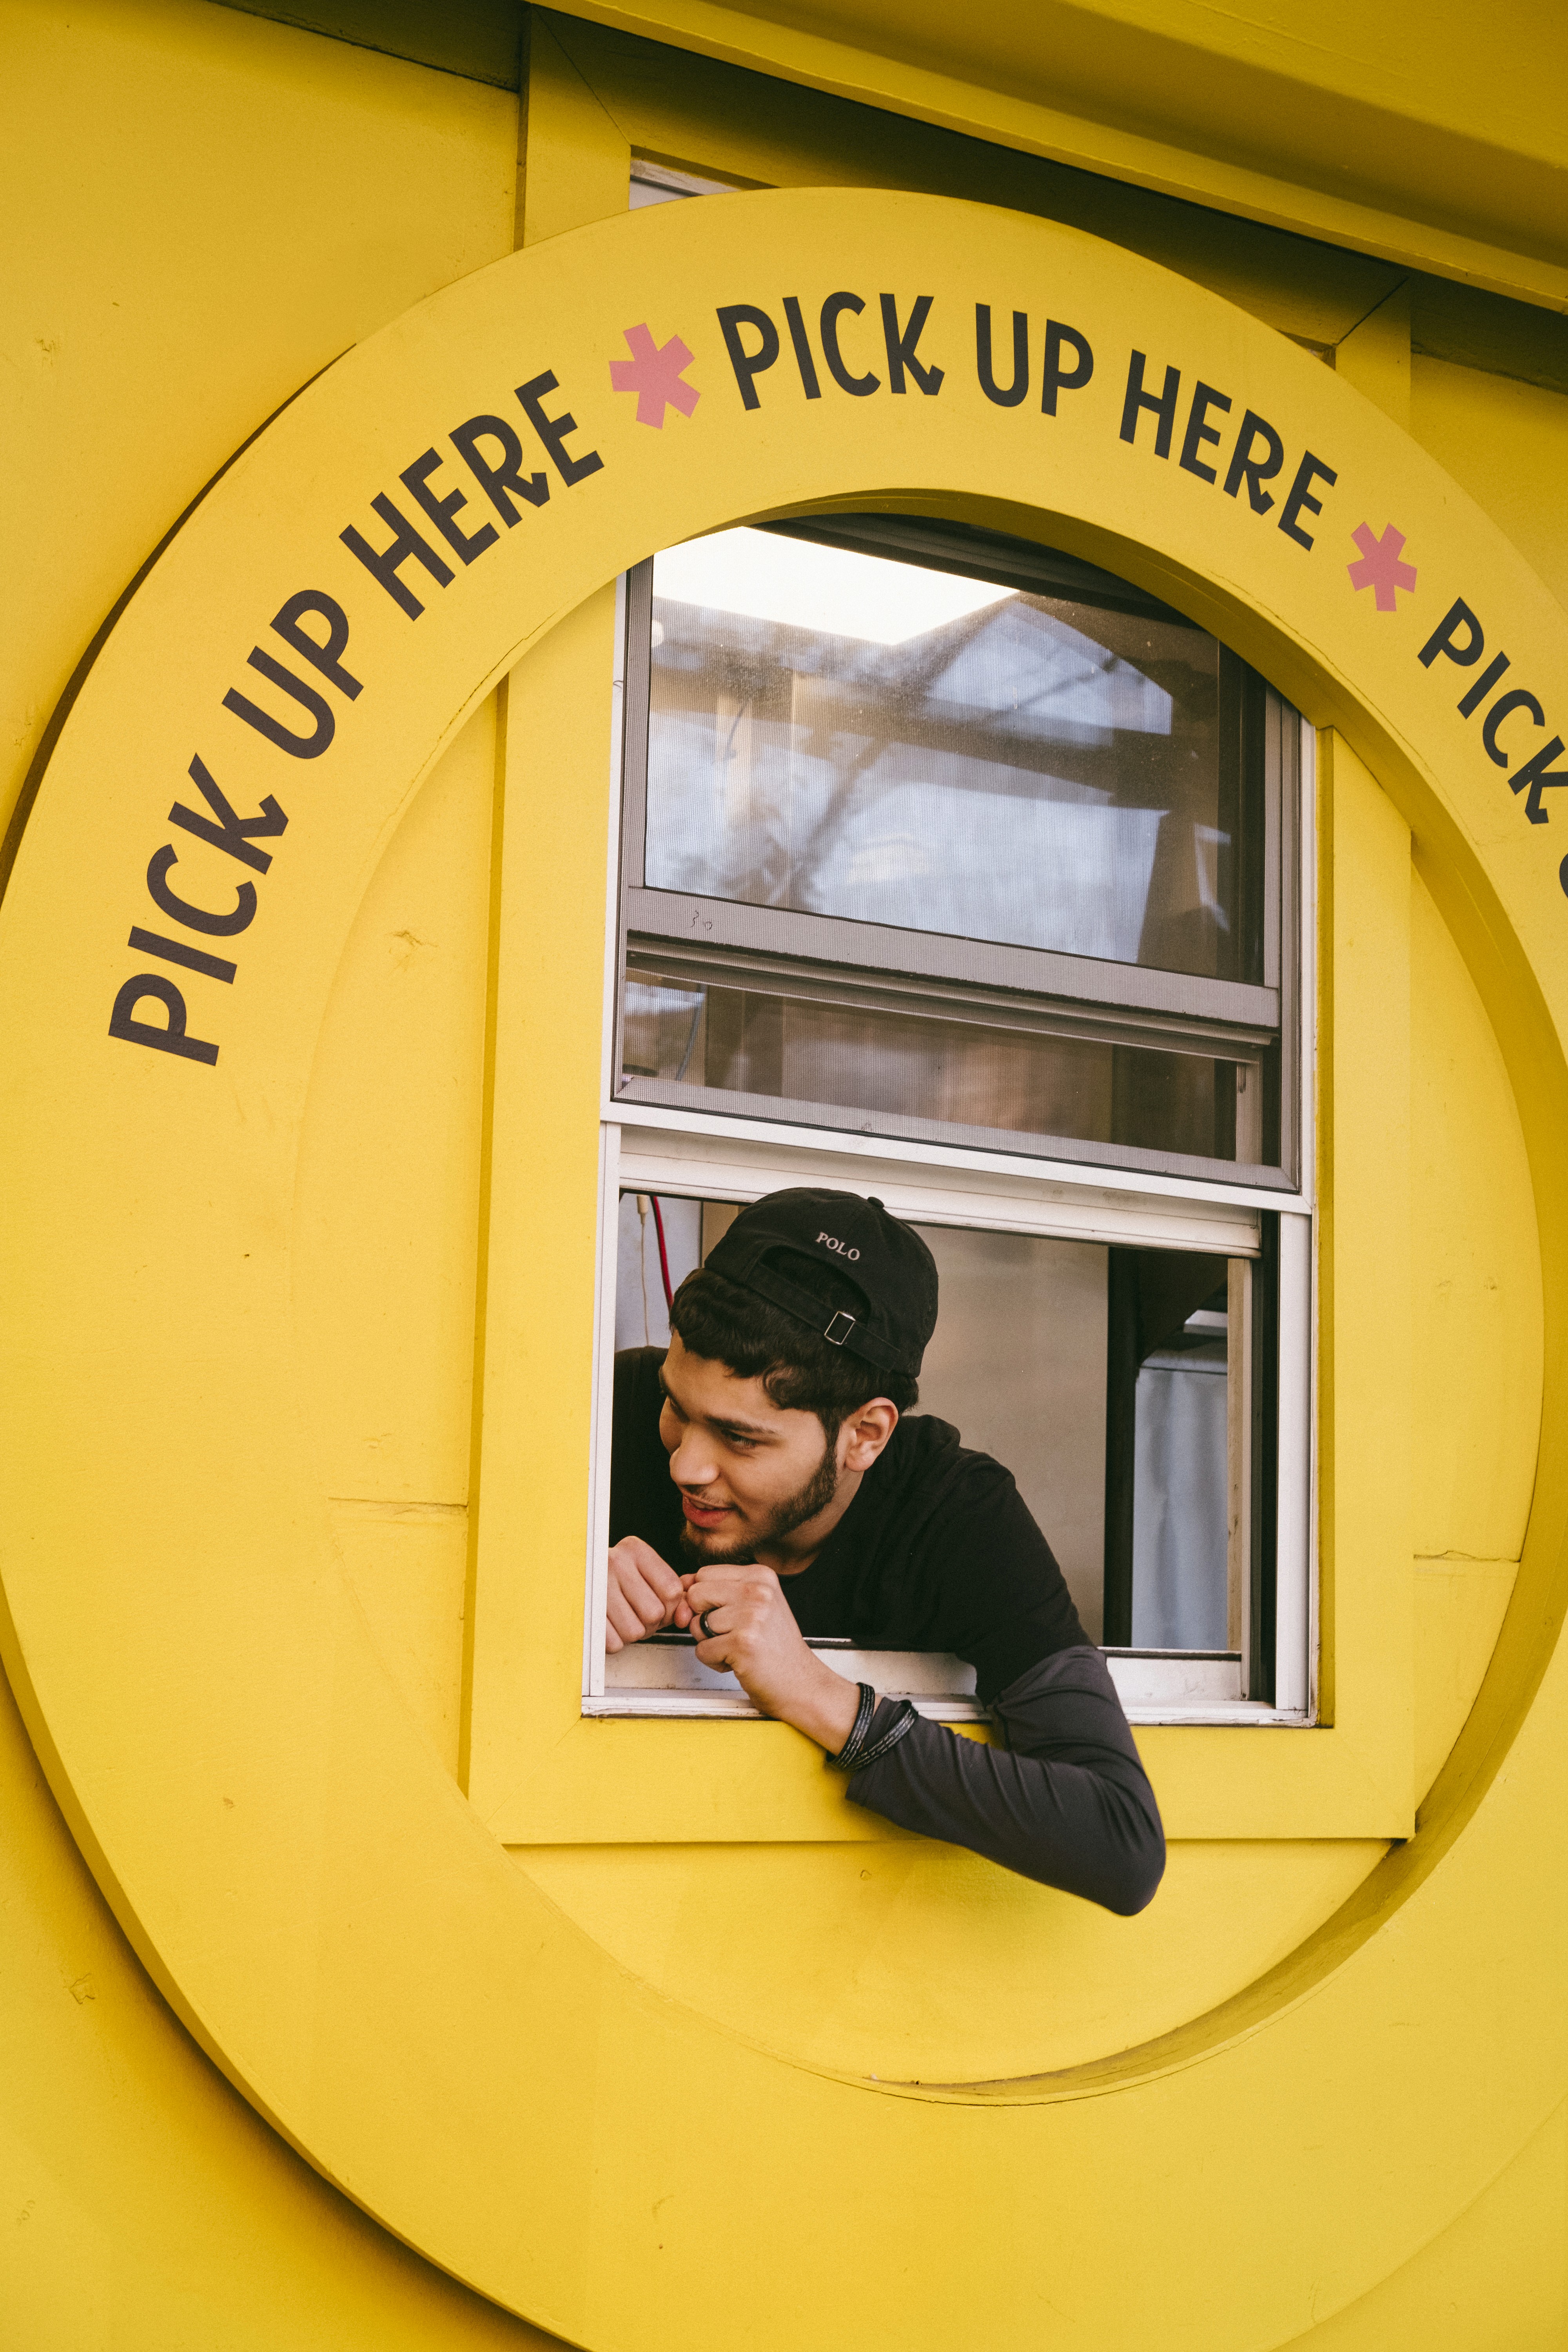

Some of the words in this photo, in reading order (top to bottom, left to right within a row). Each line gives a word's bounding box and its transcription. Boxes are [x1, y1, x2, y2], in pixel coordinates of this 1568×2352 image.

[717, 292, 944, 410] PICK
[976, 303, 1093, 416] UP
[1120, 350, 1337, 551] HERE
[109, 753, 289, 1065] PICK
[222, 590, 363, 759] UP
[339, 370, 604, 621] HERE
[1418, 597, 1568, 824] PICK
[815, 1232, 860, 1260] POLO
